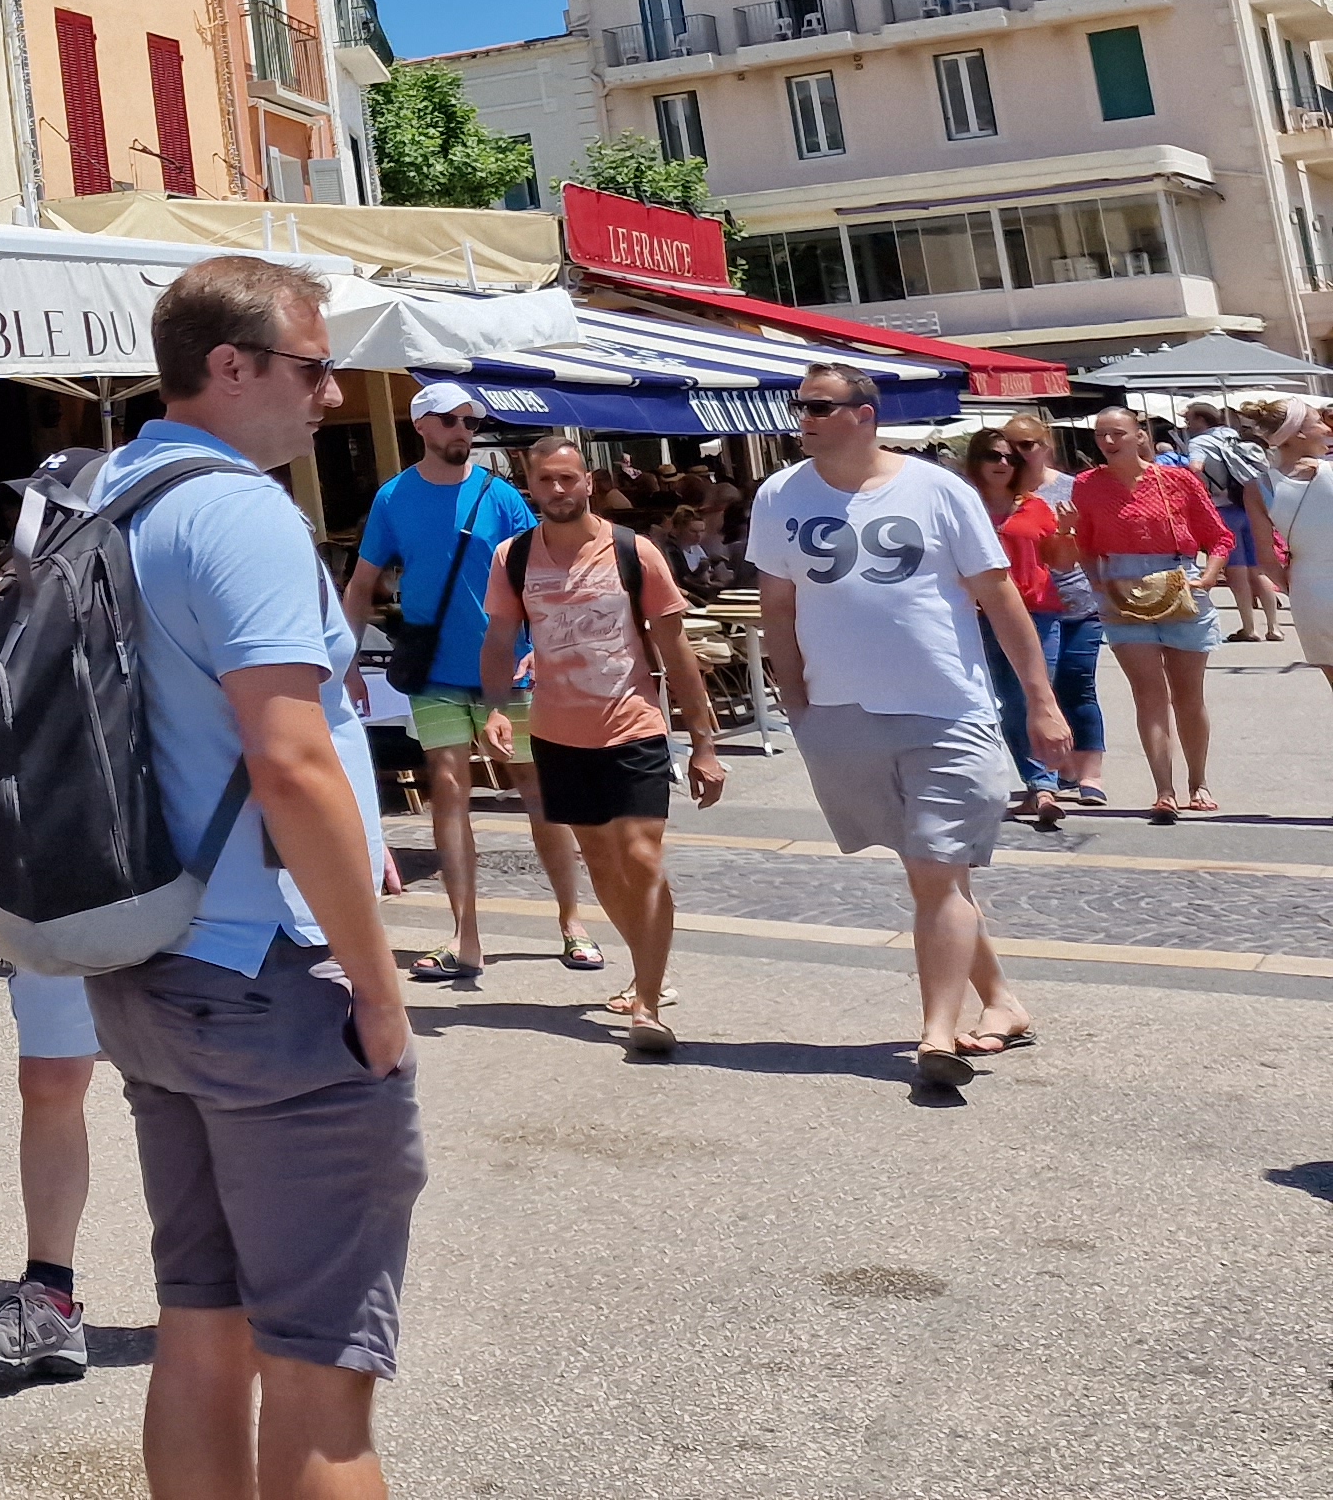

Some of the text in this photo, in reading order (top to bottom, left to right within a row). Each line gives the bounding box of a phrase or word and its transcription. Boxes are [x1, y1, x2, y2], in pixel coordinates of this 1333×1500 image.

[607, 225, 693, 277] LE FRANCE
[83, 311, 137, 357] DU
[722, 390, 754, 431] DE
[744, 390, 773, 431] LA
